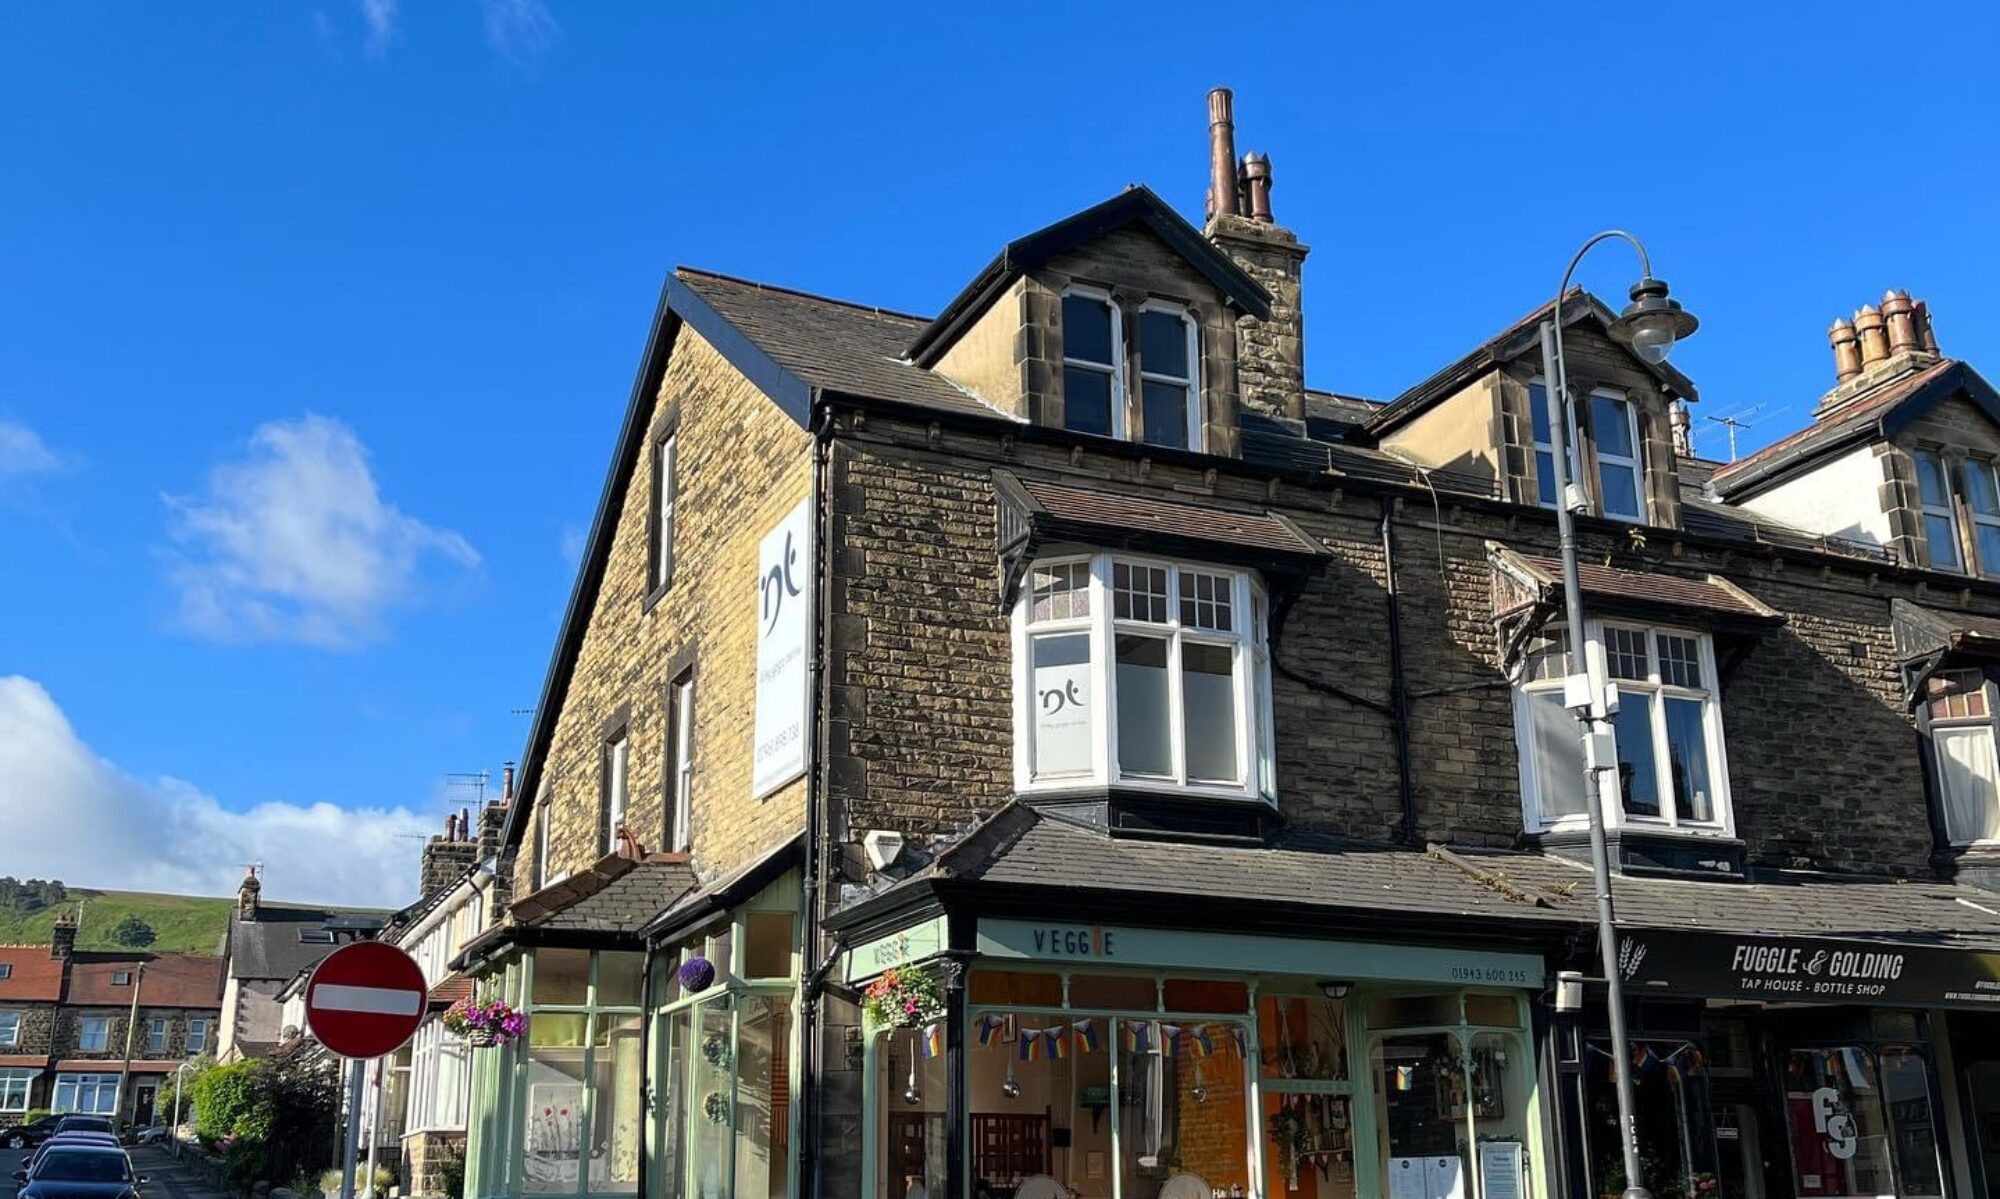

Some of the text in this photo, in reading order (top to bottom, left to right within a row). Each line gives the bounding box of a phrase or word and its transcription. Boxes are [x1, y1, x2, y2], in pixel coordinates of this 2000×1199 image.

[1732, 945, 1904, 980] FUGGLE & GOLDING
[1452, 967, 1481, 980] 01943
[1486, 968, 1506, 981] 600
[1741, 977, 1762, 989] TAP
[1764, 979, 1802, 992] HOUSE
[1814, 982, 1854, 994] BOTTLE
[1856, 984, 1886, 995] SHOP
